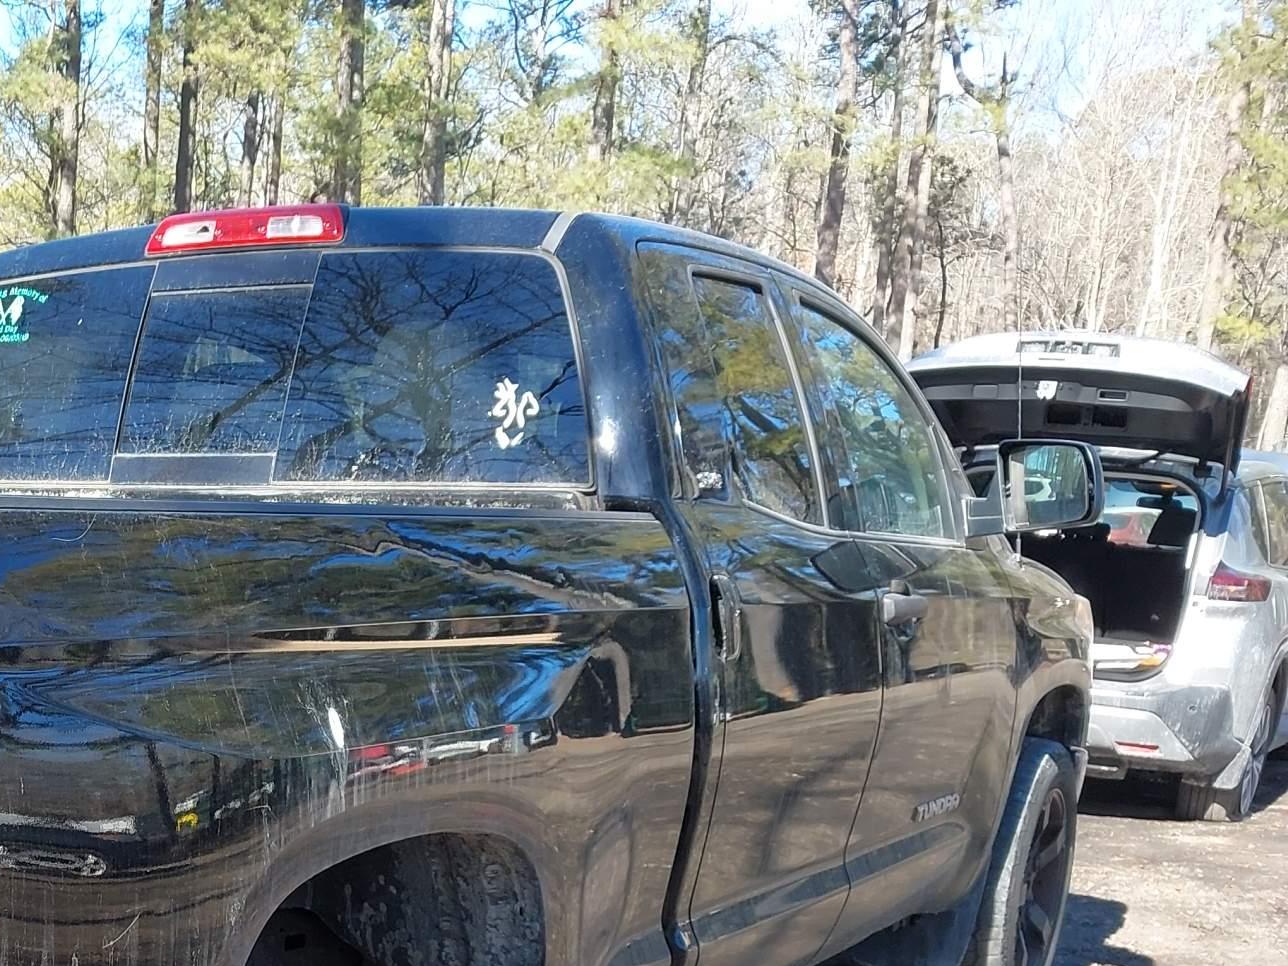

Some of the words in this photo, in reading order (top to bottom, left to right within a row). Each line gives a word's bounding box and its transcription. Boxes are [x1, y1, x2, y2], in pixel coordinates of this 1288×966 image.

[9, 286, 40, 301] Memory
[38, 295, 49, 304] of
[4, 325, 19, 334] Day
[915, 793, 961, 822] TUNDRA
